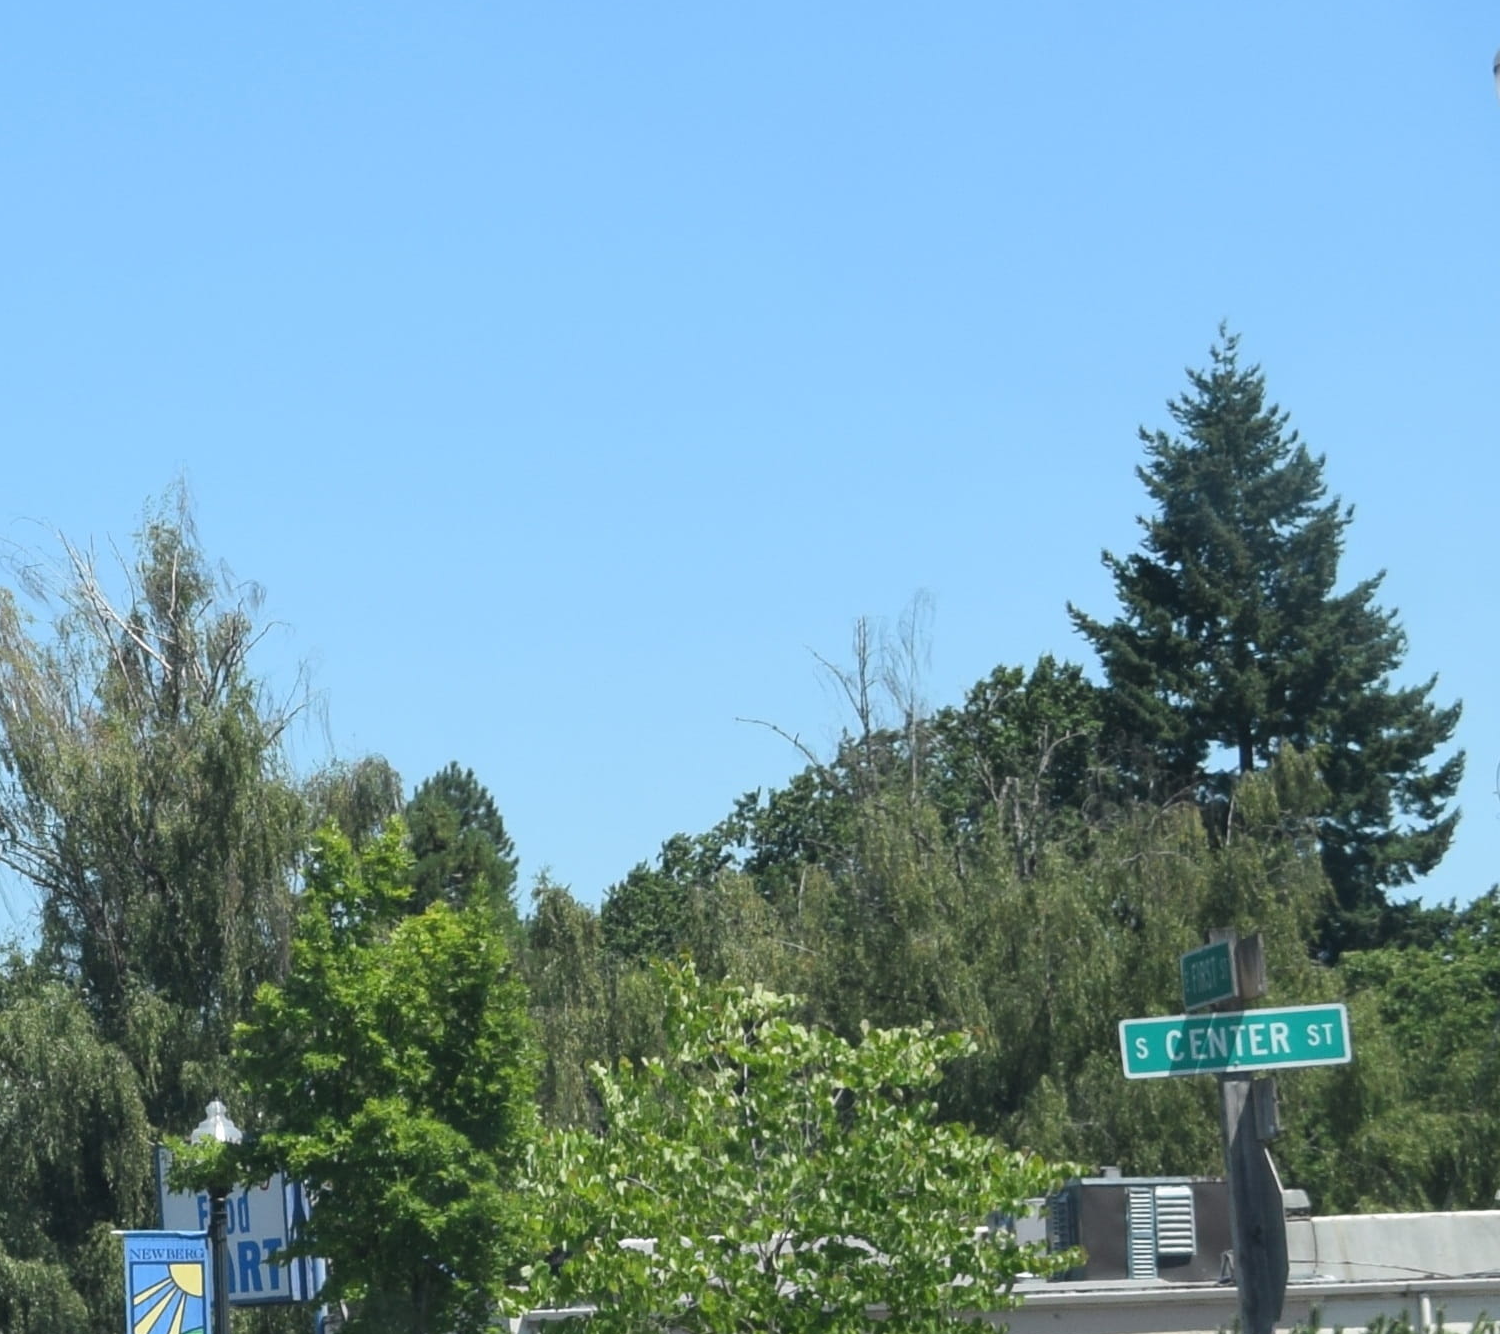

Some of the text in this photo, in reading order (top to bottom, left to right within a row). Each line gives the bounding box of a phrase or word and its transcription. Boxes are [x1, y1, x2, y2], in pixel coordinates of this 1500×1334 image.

[1135, 1021, 1334, 1062] S CENTER ST
[197, 1188, 251, 1236] Fod
[130, 1246, 205, 1261] NEWBERG
